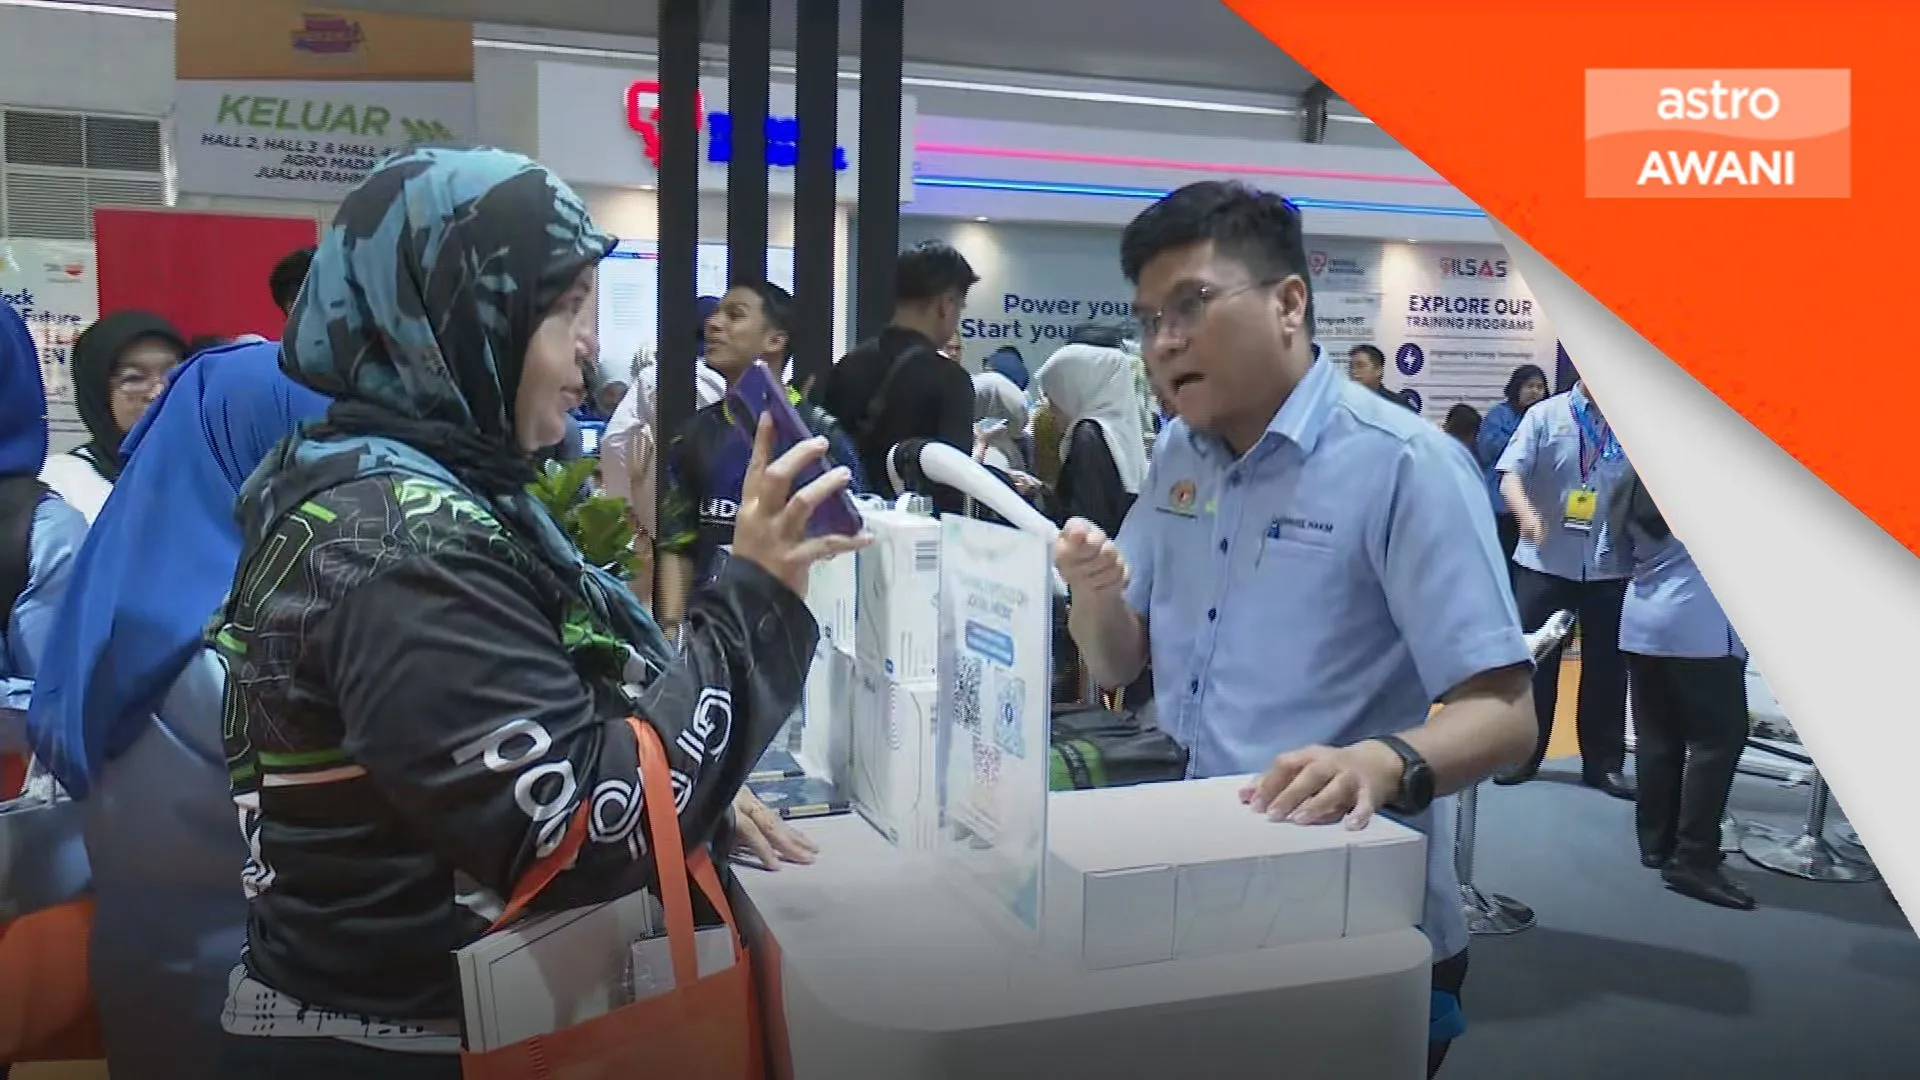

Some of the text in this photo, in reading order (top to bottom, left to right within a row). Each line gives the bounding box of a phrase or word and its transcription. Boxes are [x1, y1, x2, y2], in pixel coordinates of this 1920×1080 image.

[216, 94, 391, 136] KELUAR
[201, 133, 243, 148] HALL
[263, 137, 304, 152] HALL
[307, 140, 318, 153] 3
[324, 142, 335, 154] &
[337, 143, 377, 158] HALL
[282, 153, 327, 168] AGRO
[254, 166, 318, 182] JUALAN
[22, 307, 81, 325] Future
[1004, 293, 1133, 319] Power you
[1408, 294, 1533, 316] EXPLORE OUR
[960, 317, 1022, 339] Start
[1406, 316, 1535, 332] TRAINING PROGRAMS
